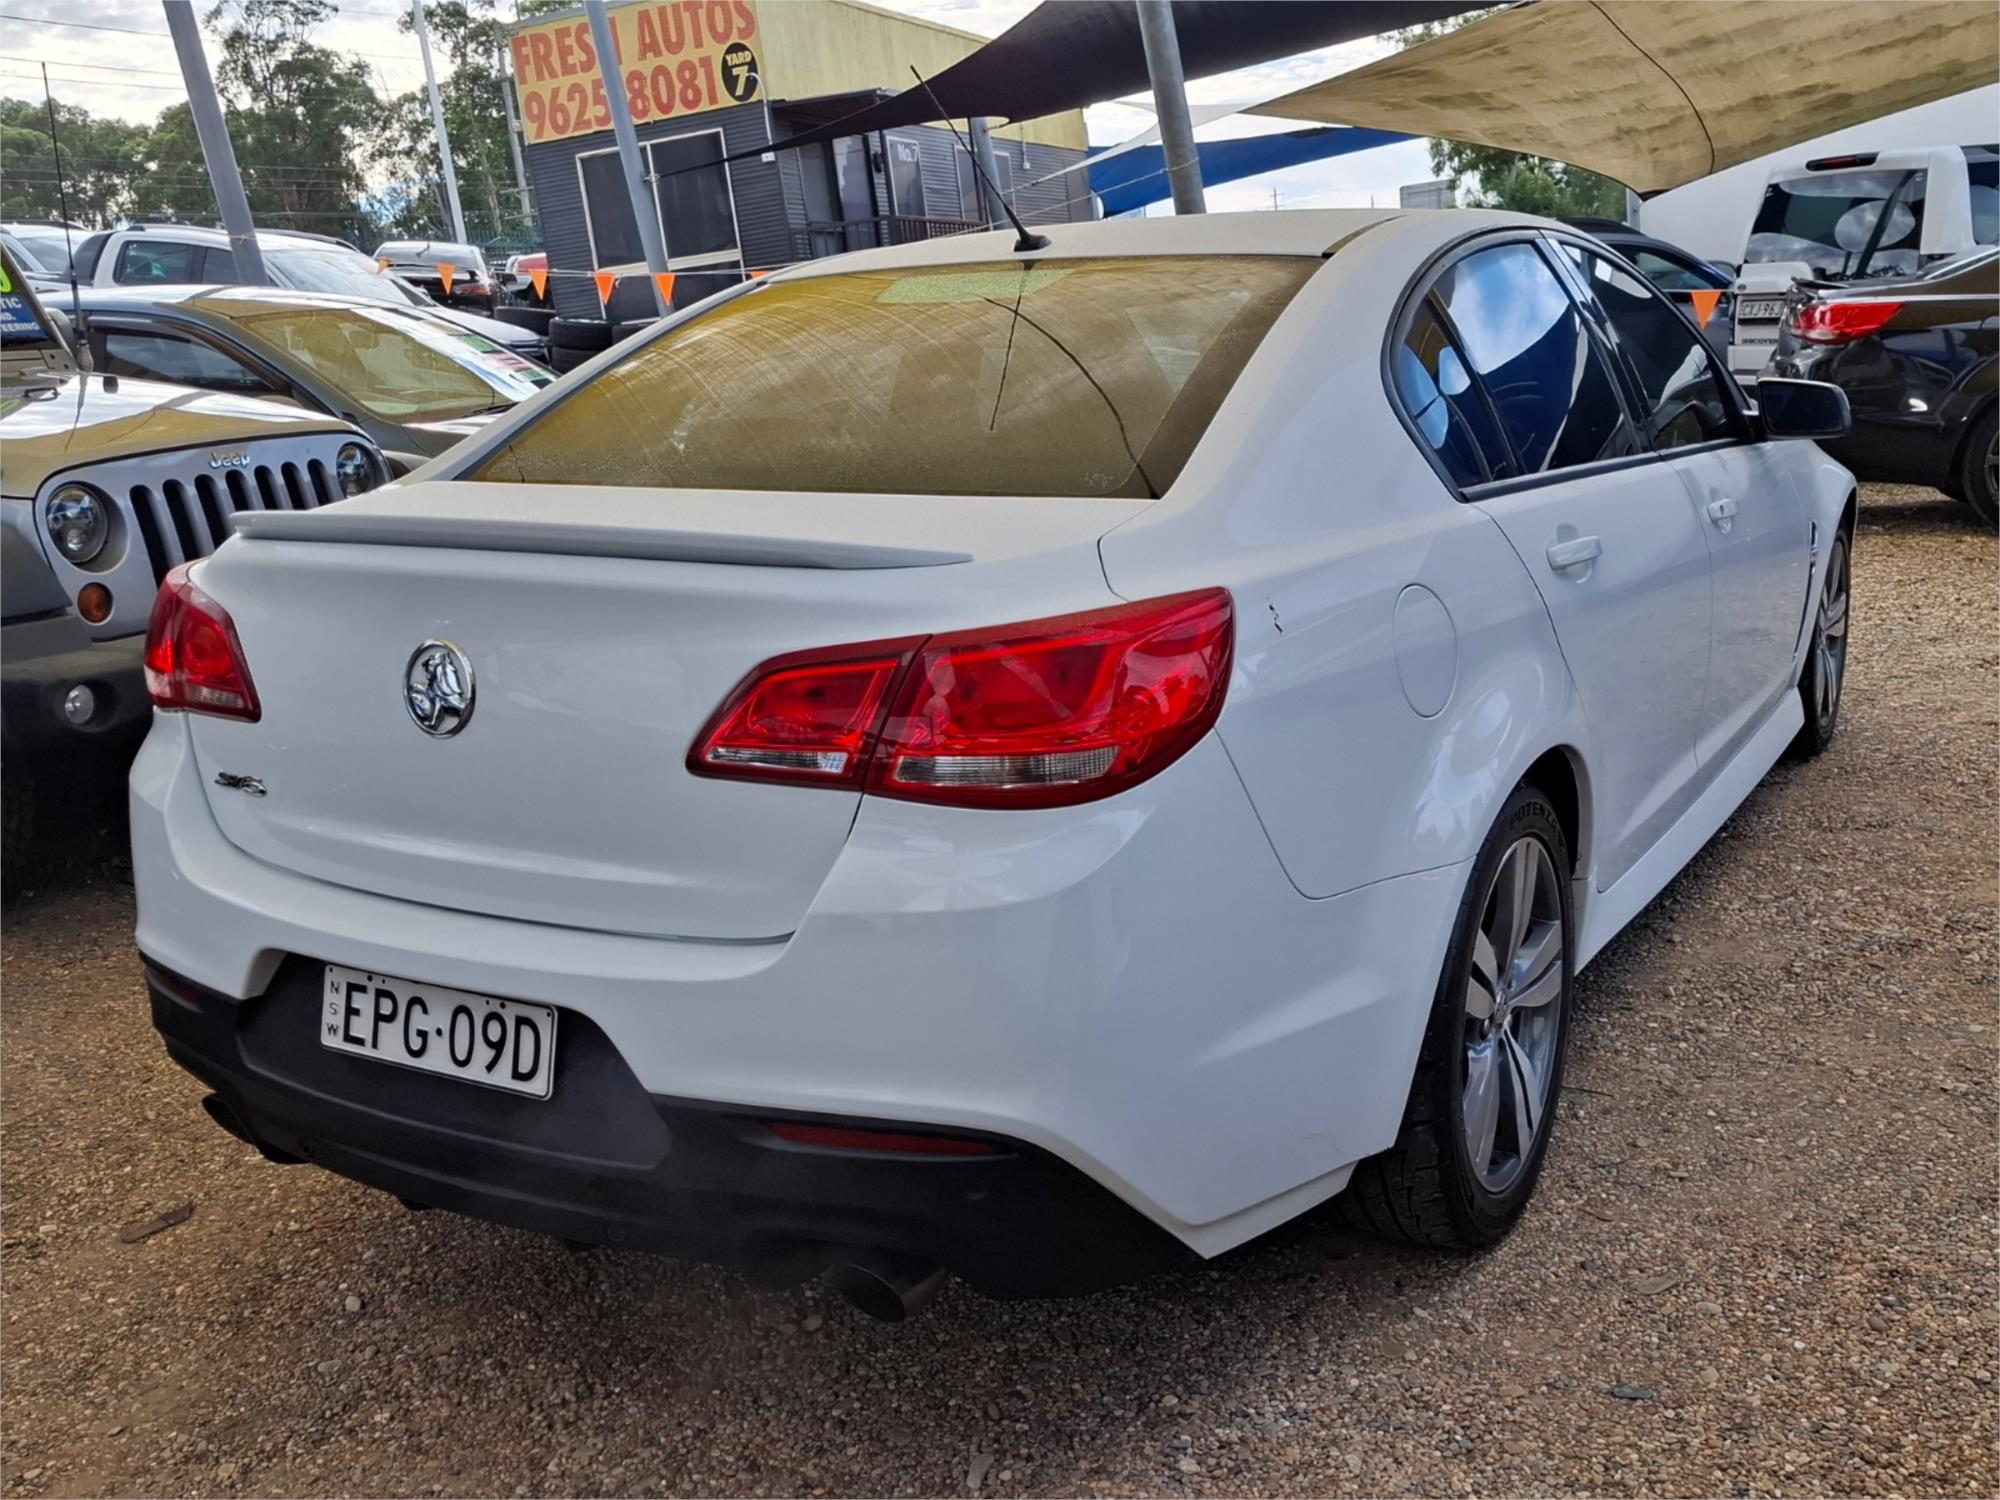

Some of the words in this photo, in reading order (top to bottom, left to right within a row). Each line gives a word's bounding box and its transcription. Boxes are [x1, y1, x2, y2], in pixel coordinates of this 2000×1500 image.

[637, 0, 756, 61] AUTOS
[725, 50, 752, 65] YARD
[732, 65, 750, 97] 7
[524, 79, 612, 139] 9625
[626, 56, 720, 120] 8081
[209, 451, 251, 469] Jeep
